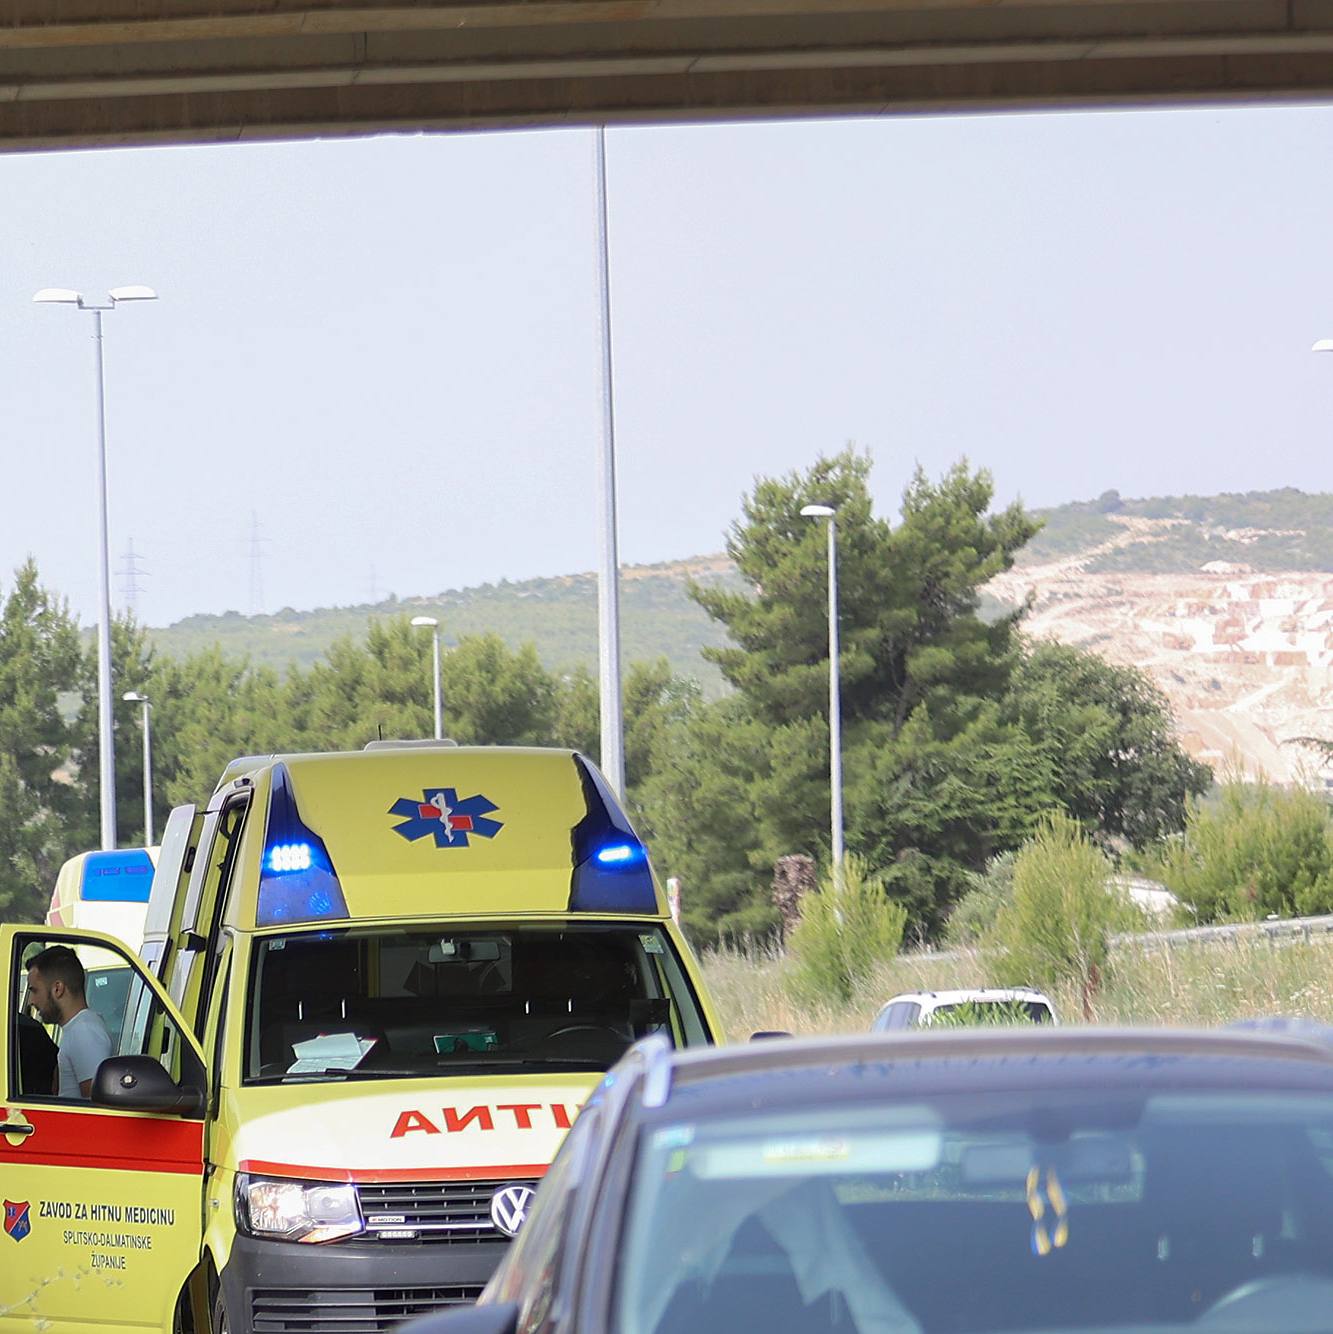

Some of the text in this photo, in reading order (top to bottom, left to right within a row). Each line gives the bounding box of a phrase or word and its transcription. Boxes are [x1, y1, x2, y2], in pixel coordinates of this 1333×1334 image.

[40, 1201, 175, 1226] ZAVOD ZA HITNU MEDICINU
[63, 1230, 152, 1250] SPLITSKO-DALMATINSKE
[91, 1251, 126, 1270] ŽUPANIJE
